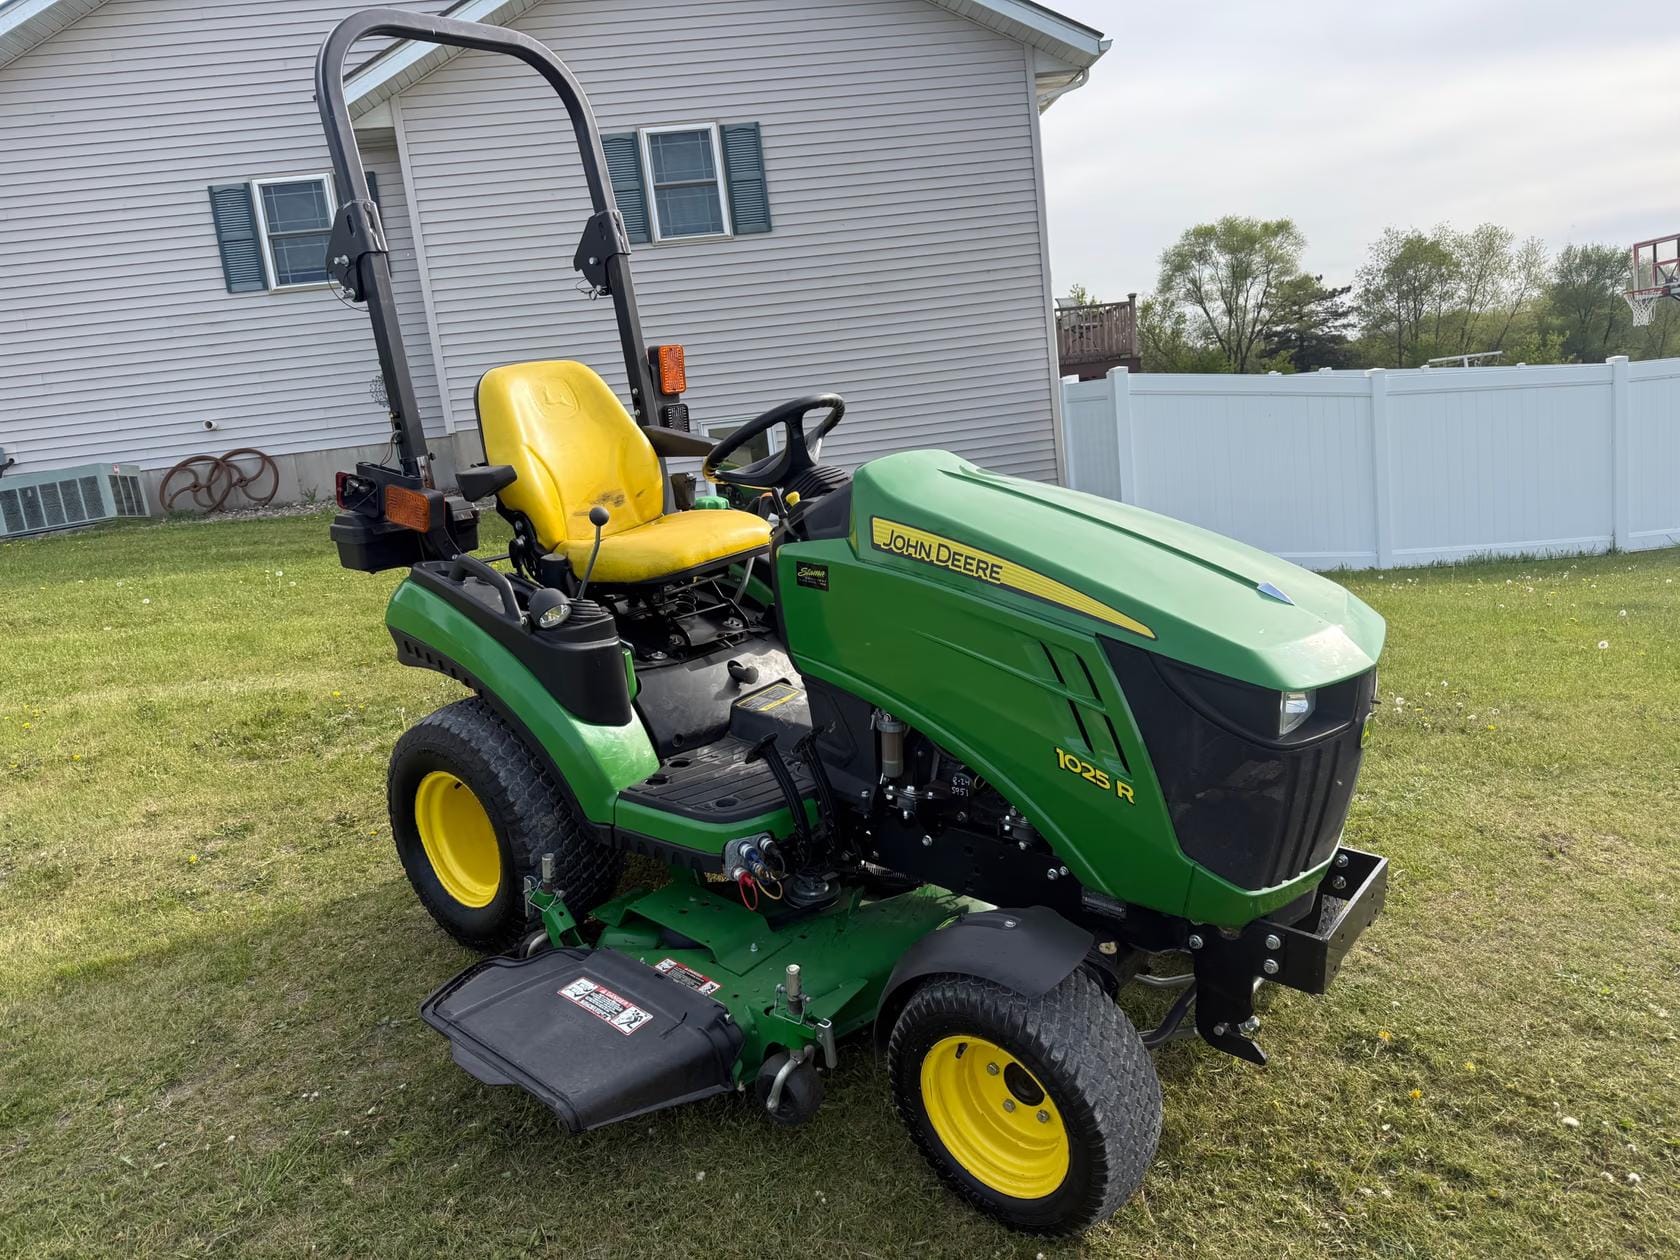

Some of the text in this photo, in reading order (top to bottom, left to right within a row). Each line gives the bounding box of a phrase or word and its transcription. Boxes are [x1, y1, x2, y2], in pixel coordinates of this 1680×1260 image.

[883, 529, 1003, 582] JOHN DEERE
[1056, 747, 1135, 804] 1025 R
